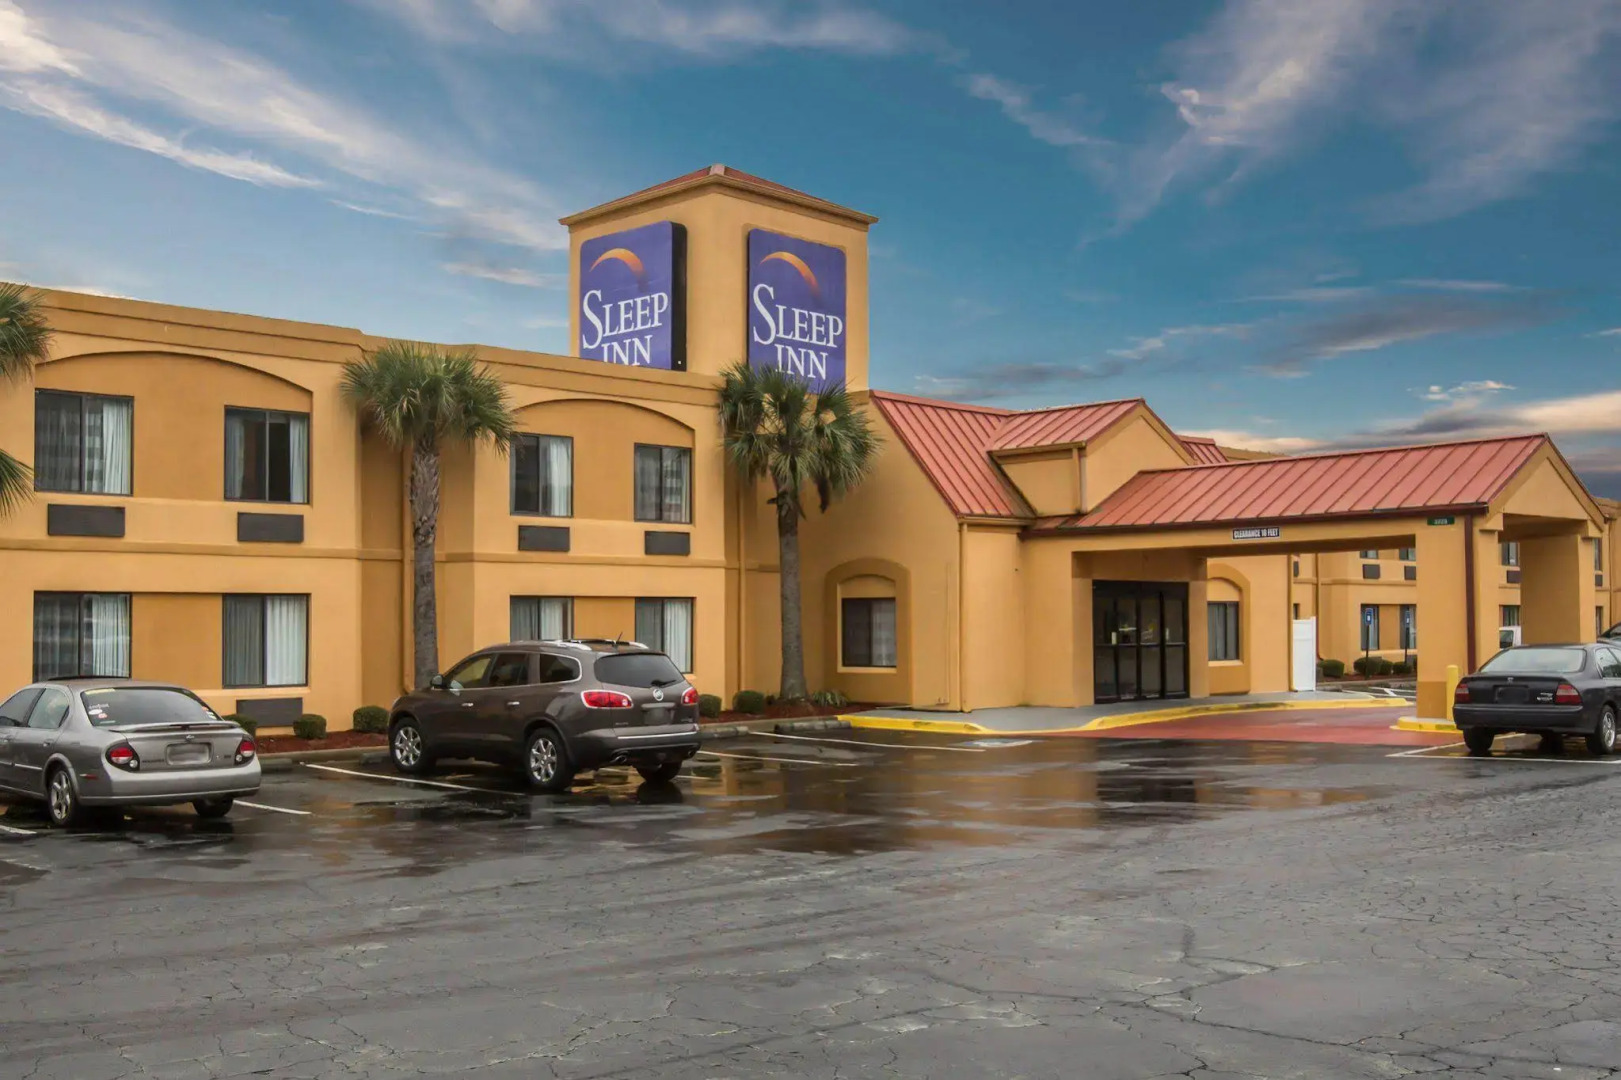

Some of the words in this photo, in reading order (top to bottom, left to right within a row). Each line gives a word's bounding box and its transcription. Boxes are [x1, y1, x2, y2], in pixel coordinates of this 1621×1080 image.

[583, 290, 668, 349] SLEEP
[753, 284, 843, 348] SLEEP
[602, 335, 653, 366] INN
[774, 344, 828, 380] INN
[1234, 529, 1260, 538] CLEARANCE
[1267, 528, 1278, 536] FEET
